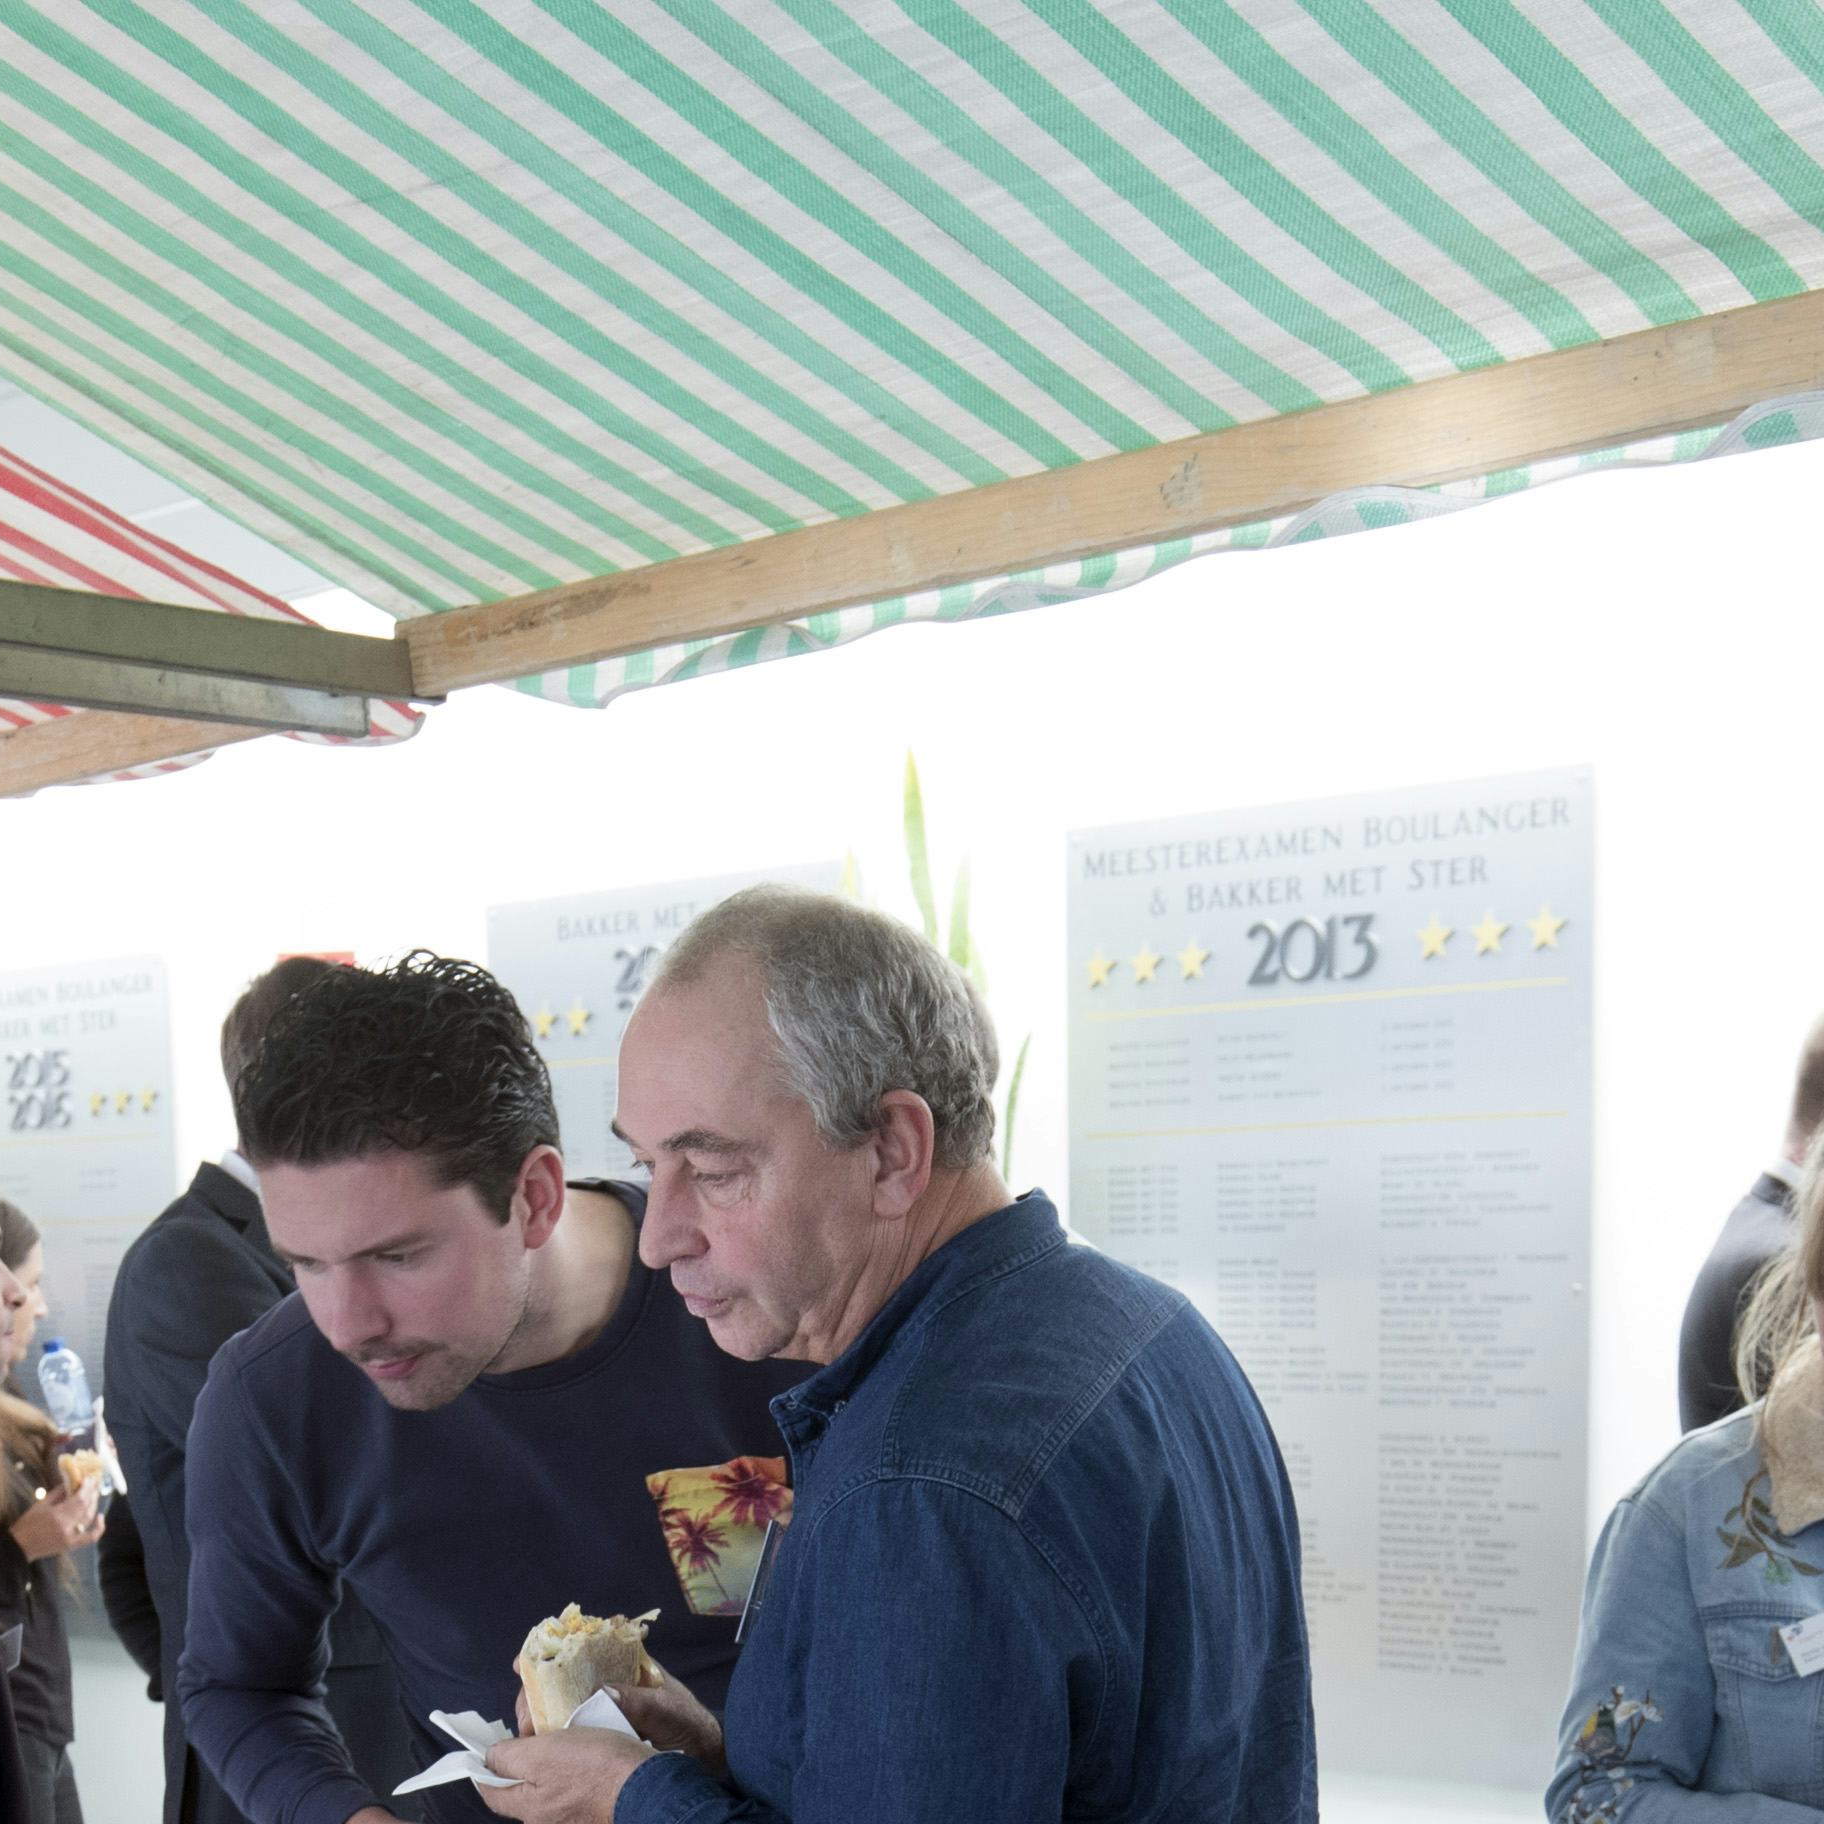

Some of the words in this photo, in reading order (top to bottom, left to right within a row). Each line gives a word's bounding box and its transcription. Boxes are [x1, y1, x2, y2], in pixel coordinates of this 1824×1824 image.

[1083, 822, 1343, 880] MEESTEREXAMEN
[1363, 796, 1570, 849] BOULANGER
[1149, 888, 1168, 917] &
[1186, 875, 1303, 914] BAKKER
[1324, 865, 1387, 900] MET
[1407, 855, 1489, 893] STER
[557, 911, 639, 943] BAKKER
[1246, 913, 1379, 987] 2013
